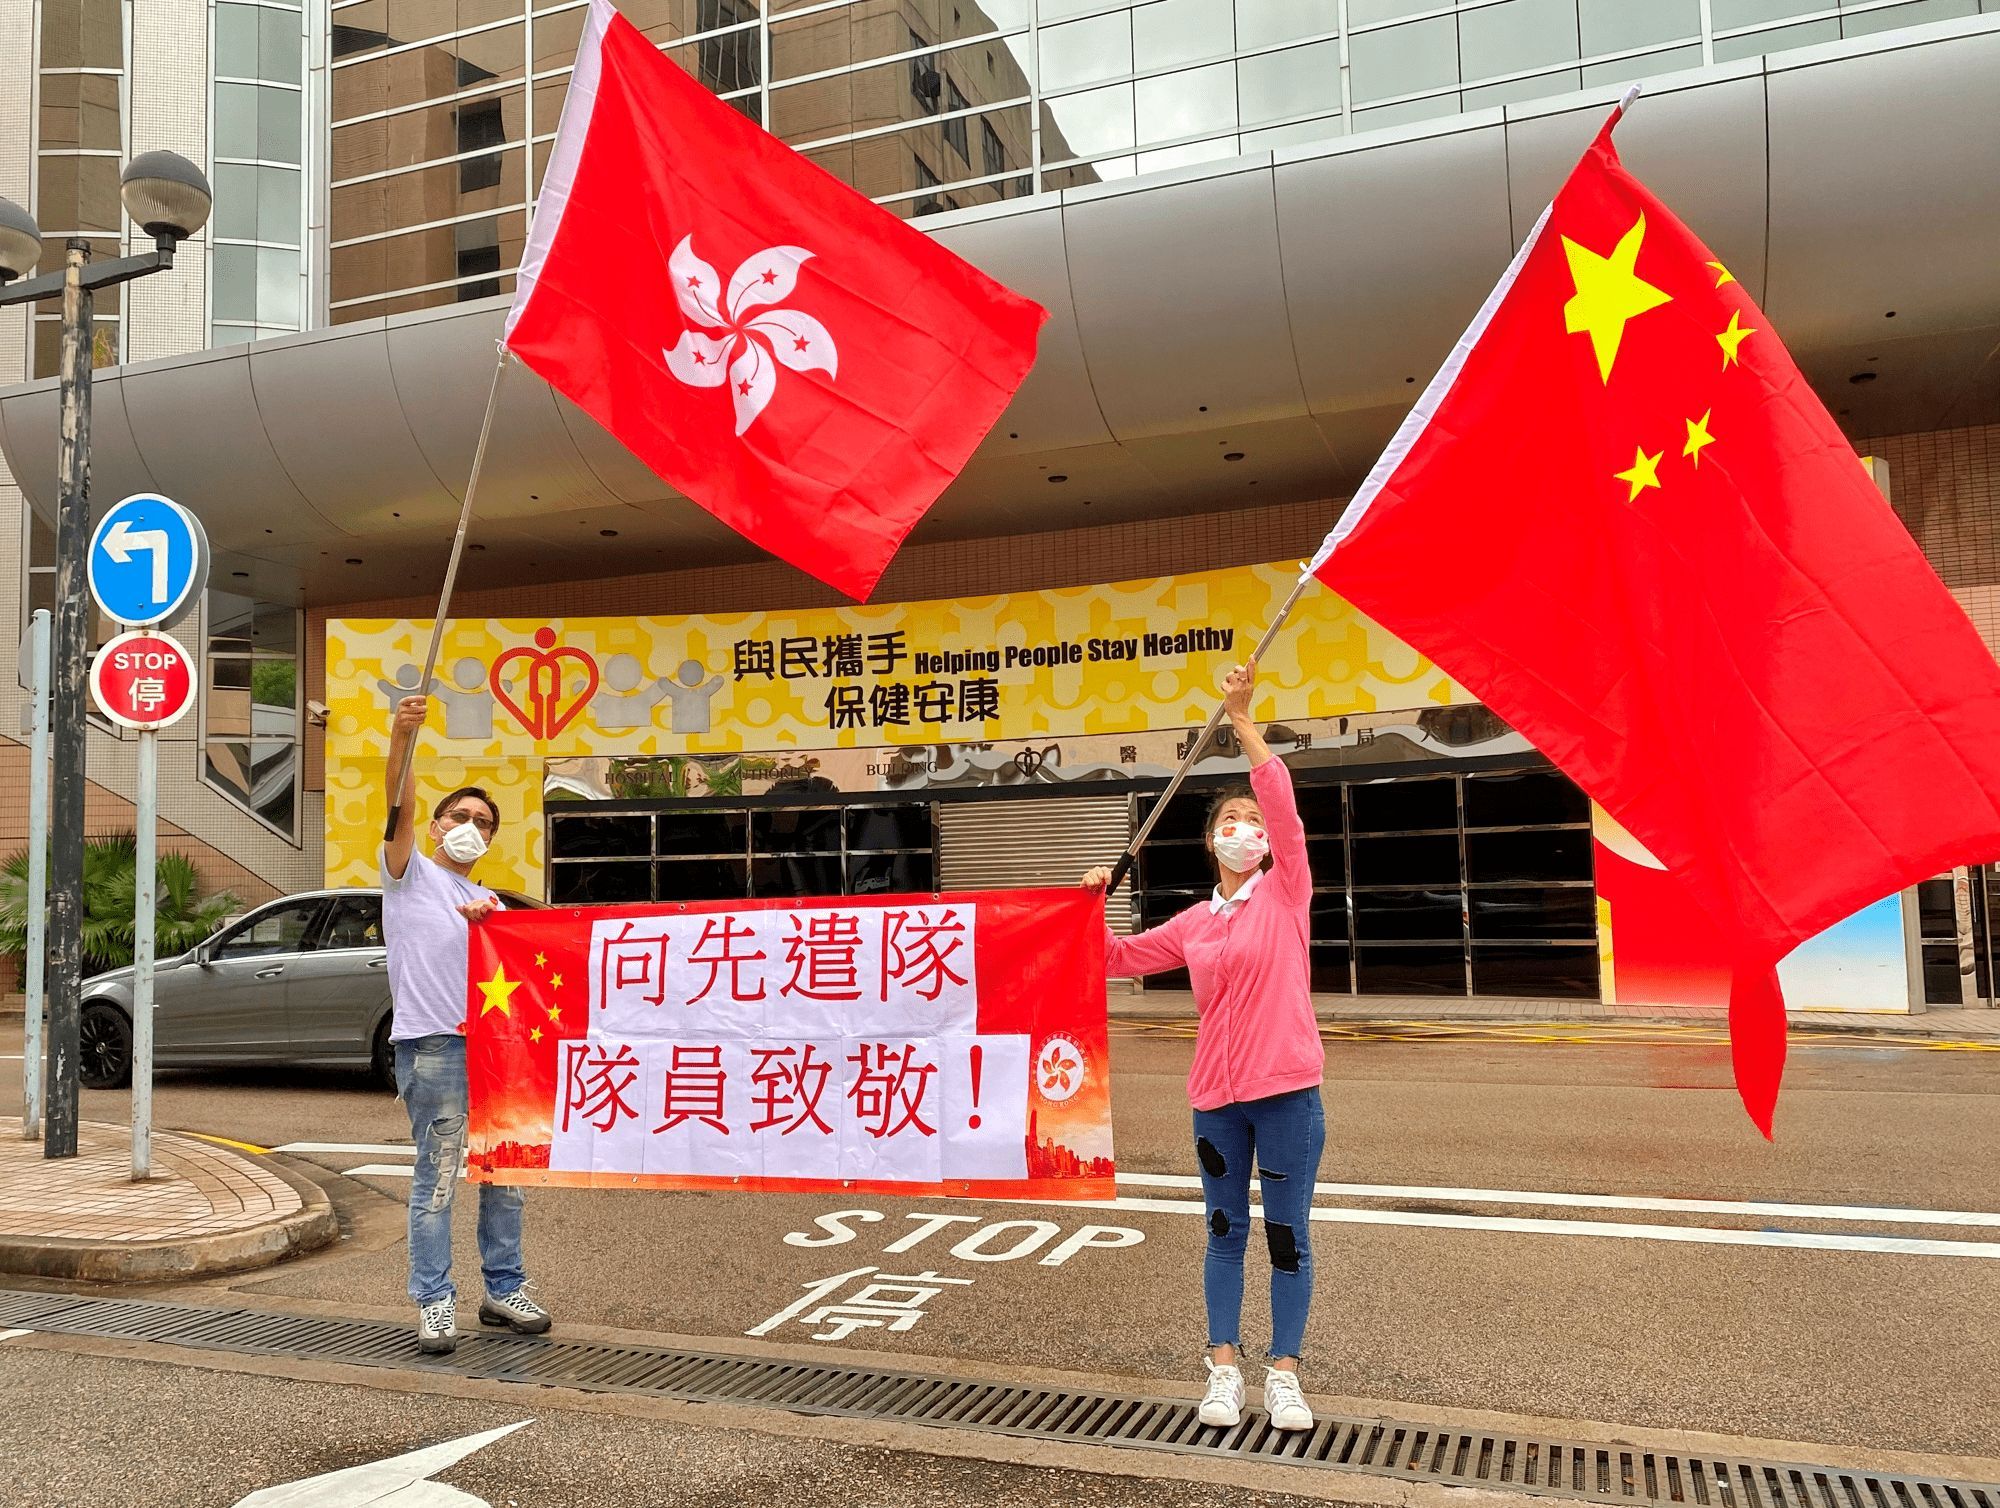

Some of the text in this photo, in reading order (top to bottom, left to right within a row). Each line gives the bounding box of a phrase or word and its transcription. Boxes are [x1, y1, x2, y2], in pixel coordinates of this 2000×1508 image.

[114, 652, 177, 671] STOP
[733, 630, 908, 682] 與民攜手
[915, 626, 1234, 675] Helping People Stay Healthy
[128, 677, 166, 712] 停
[823, 677, 1000, 730] 保健安康
[604, 761, 938, 785] HOSPITAL AUTHORITY BUILDING
[600, 910, 969, 1009] 向先遣隊
[783, 1210, 1146, 1266] STOP
[744, 1266, 976, 1341] 停
